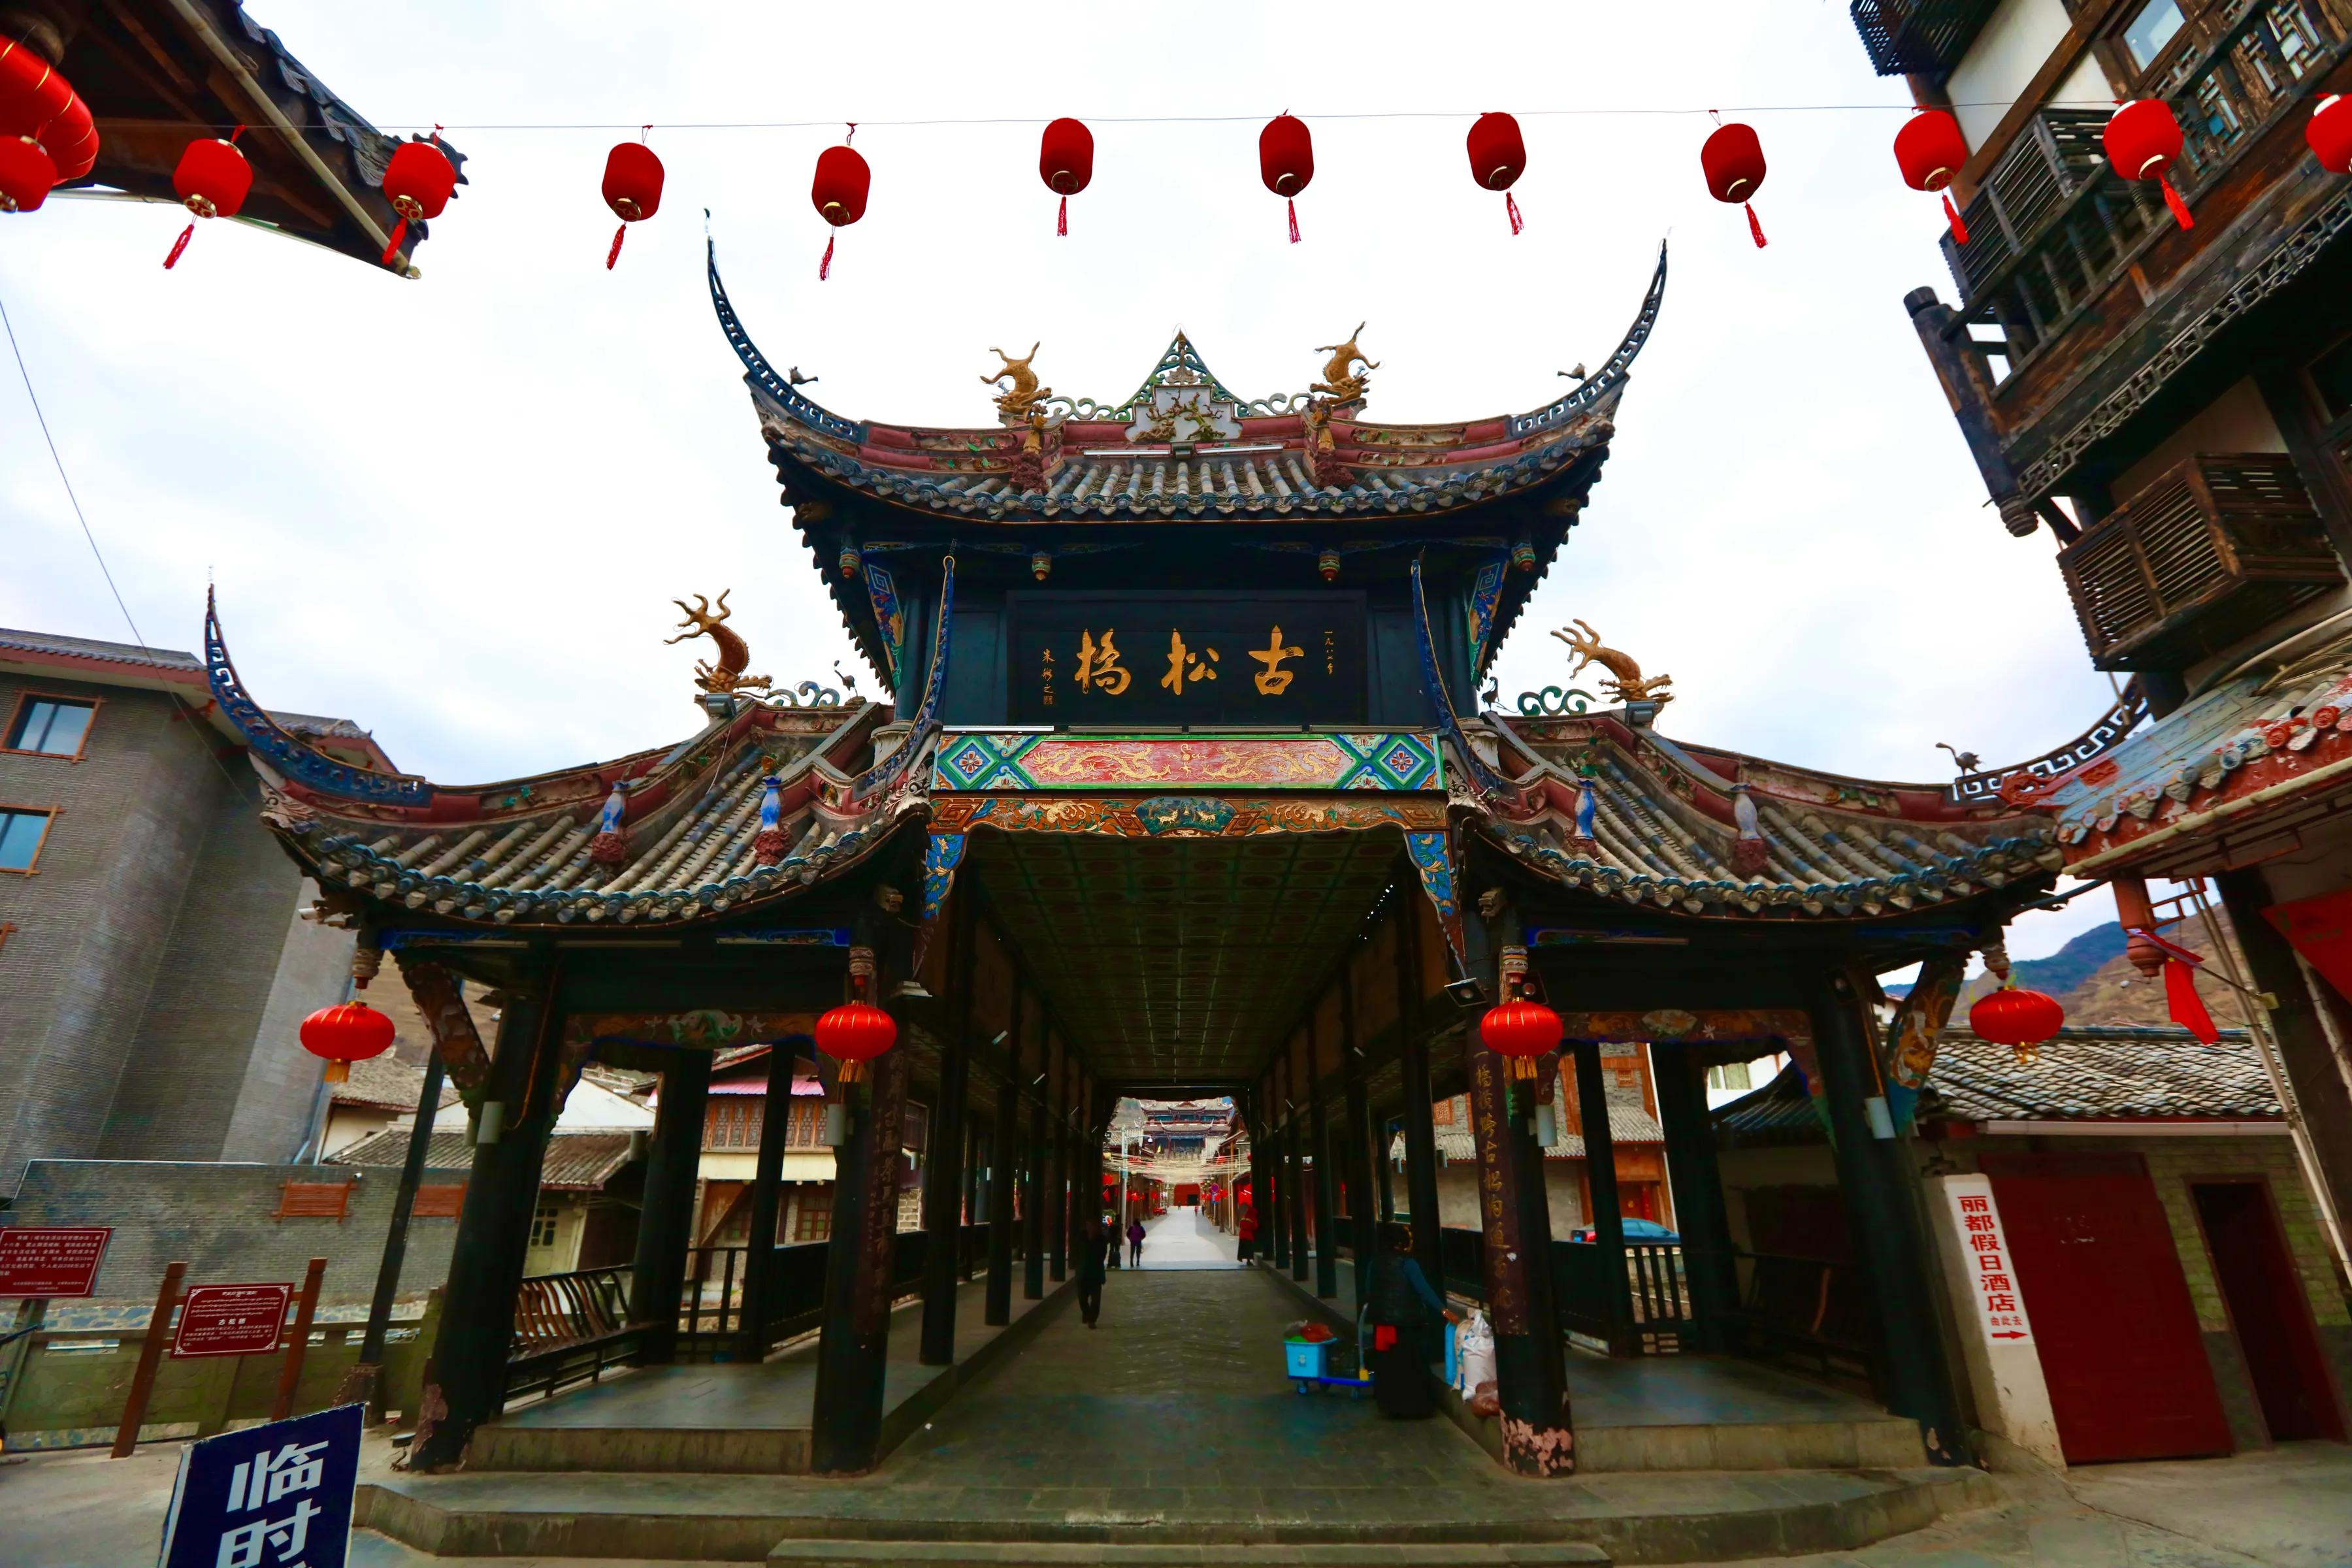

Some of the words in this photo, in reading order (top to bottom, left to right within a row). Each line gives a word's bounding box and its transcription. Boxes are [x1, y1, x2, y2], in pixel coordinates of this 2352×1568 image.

[1957, 1196, 2016, 1312] 丽都假日酒店
[216, 1440, 329, 1568] 临时
